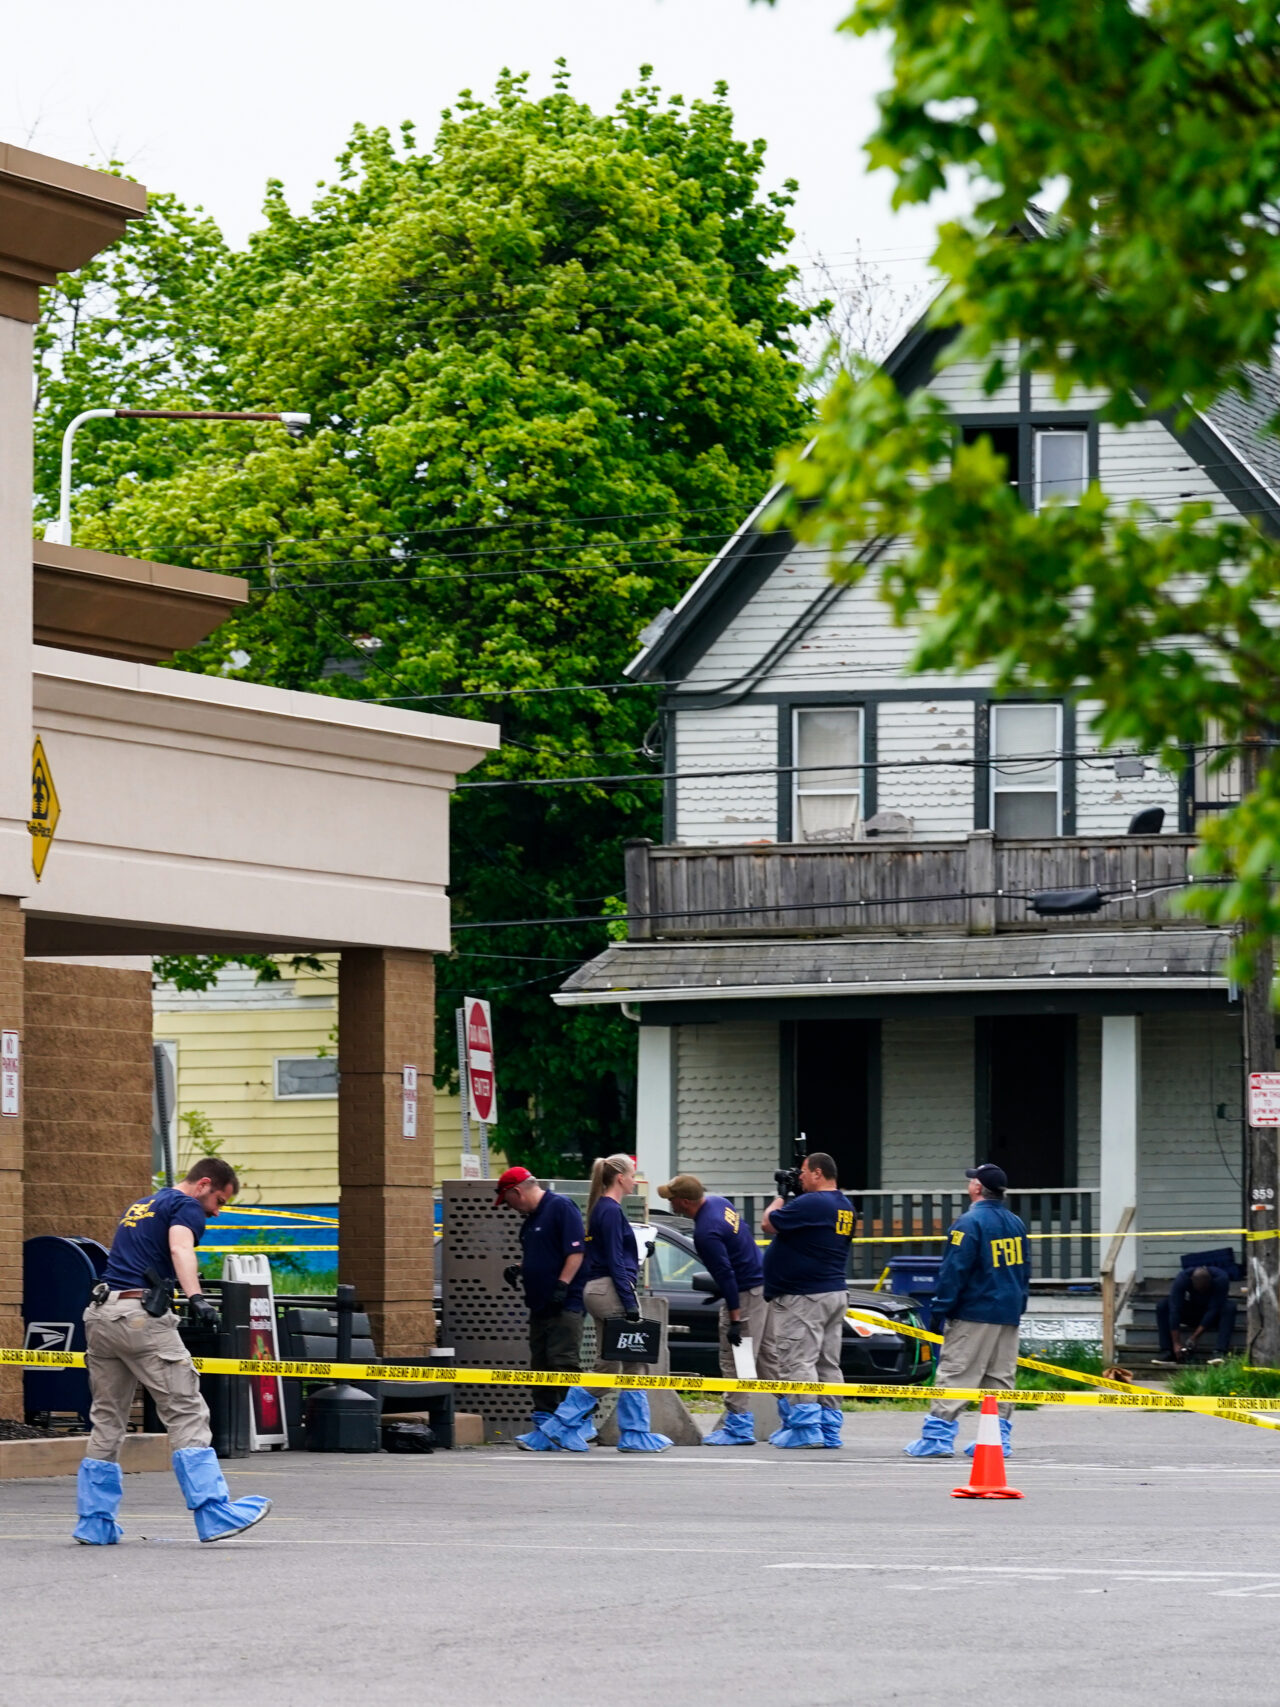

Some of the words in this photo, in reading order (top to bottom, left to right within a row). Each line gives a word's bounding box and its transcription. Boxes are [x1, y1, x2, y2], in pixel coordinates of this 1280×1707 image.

[469, 1024, 478, 1043] DO
[478, 1026, 489, 1046] NOT
[473, 1077, 490, 1097] ENTER
[990, 1236, 1024, 1268] FBI
[2, 1350, 23, 1361] SCENE
[25, 1351, 35, 1361] DO
[37, 1351, 50, 1362] NOT
[51, 1352, 73, 1363] CROSS
[239, 1360, 260, 1371] CRIME
[261, 1361, 282, 1372] SCENE
[284, 1362, 294, 1373] DO
[295, 1363, 308, 1374] NOT
[309, 1364, 331, 1374] CROSS
[366, 1366, 387, 1377] CRIME
[388, 1367, 409, 1377] SCENE
[411, 1367, 420, 1378] DO
[422, 1368, 434, 1378] NOT
[435, 1368, 457, 1379] CROSS
[491, 1371, 512, 1381] CRIME
[513, 1372, 534, 1382] SCENE
[535, 1372, 545, 1382] DO
[546, 1373, 559, 1383] NOT
[560, 1373, 581, 1384] CROSS
[615, 1376, 636, 1386] CRIME
[636, 1377, 657, 1386] SCENE
[658, 1377, 668, 1387] DO
[669, 1378, 682, 1387] NOT
[682, 1378, 704, 1388] CROSS
[736, 1380, 757, 1390] CRIME
[758, 1381, 779, 1391] SCENE
[779, 1382, 790, 1391] DO
[790, 1382, 803, 1392] NOT
[803, 1383, 825, 1393] CROSS
[1031, 1392, 1044, 1401] NOT
[1045, 1393, 1066, 1402] CROSS
[1098, 1394, 1119, 1404] CRIME
[1120, 1395, 1140, 1405] SCENE
[1141, 1396, 1150, 1405] DO
[1151, 1396, 1163, 1406] NOT
[1164, 1396, 1184, 1406] CROSS
[1217, 1398, 1237, 1408] CRIME
[1239, 1399, 1258, 1409] SCENE
[1260, 1400, 1269, 1409] DO
